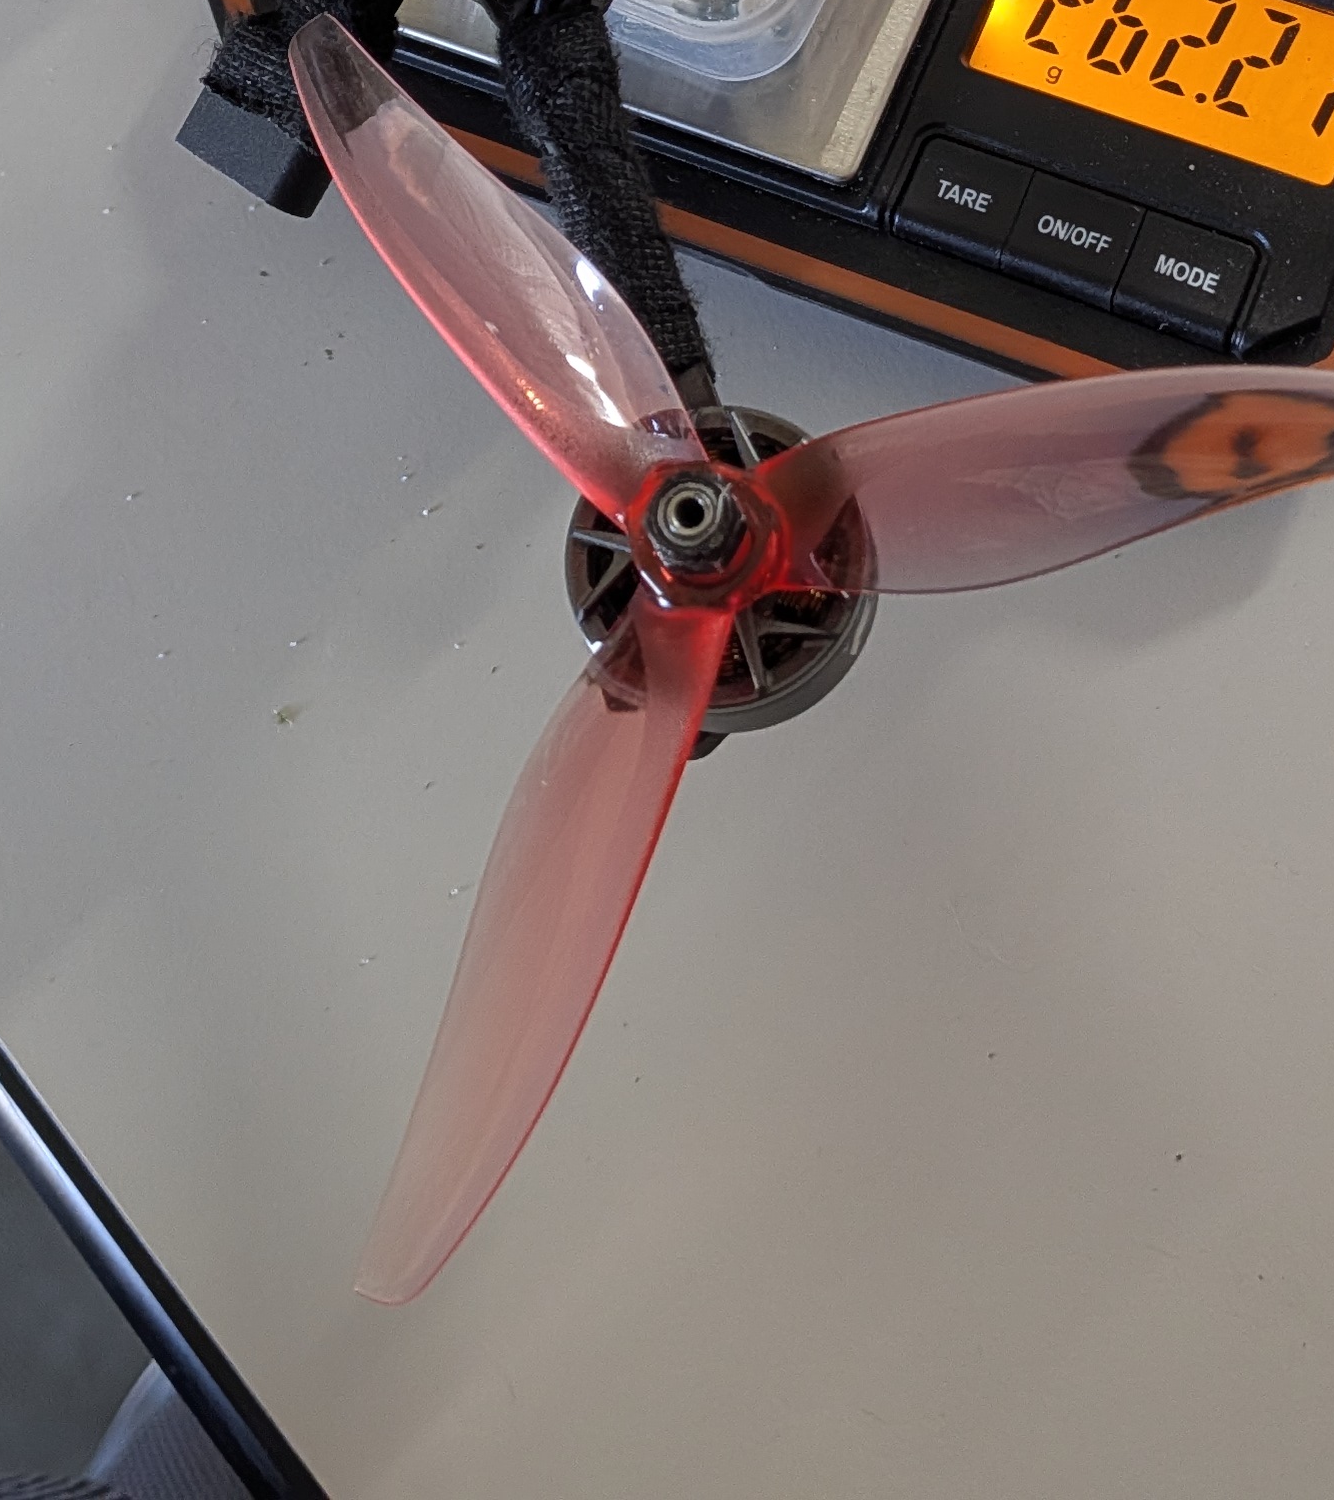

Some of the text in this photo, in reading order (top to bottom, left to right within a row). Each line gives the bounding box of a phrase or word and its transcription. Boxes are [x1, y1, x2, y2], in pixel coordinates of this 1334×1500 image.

[1045, 65, 1064, 85] g
[937, 179, 992, 213] TARE
[1037, 214, 1112, 253] ON/OFF
[1153, 253, 1221, 294] MODE
